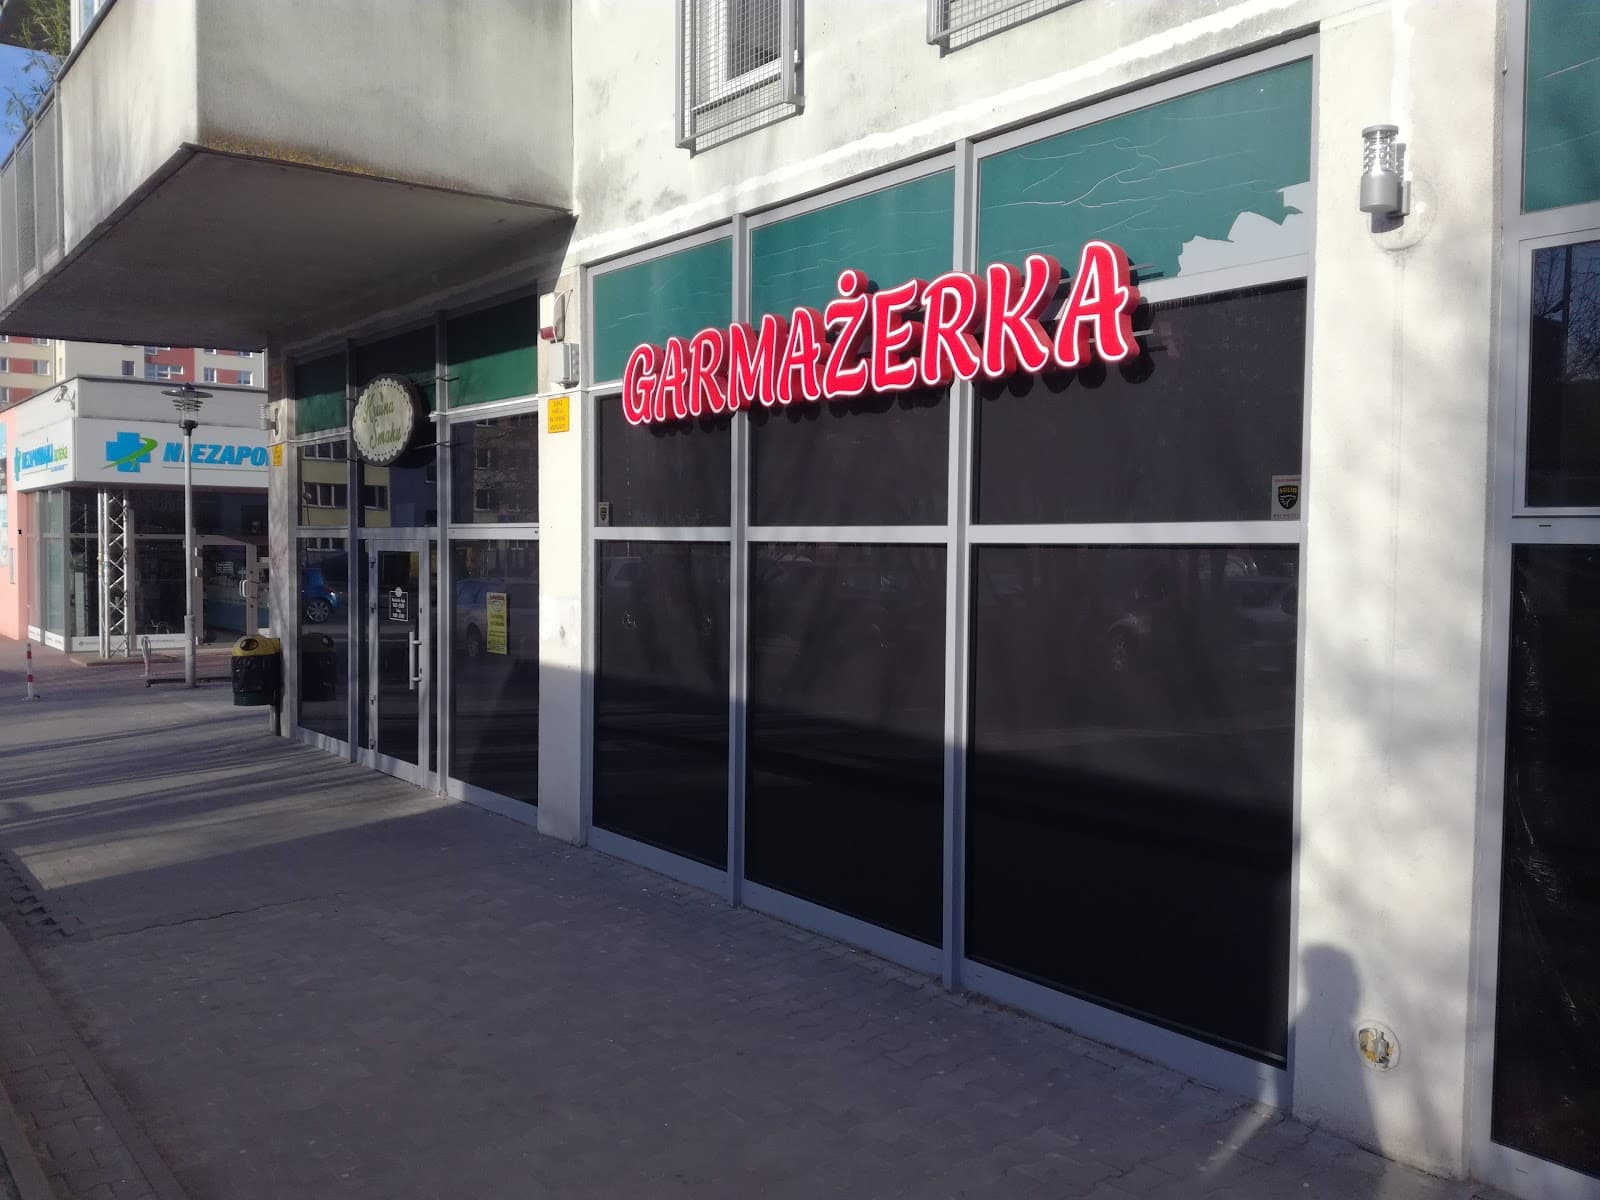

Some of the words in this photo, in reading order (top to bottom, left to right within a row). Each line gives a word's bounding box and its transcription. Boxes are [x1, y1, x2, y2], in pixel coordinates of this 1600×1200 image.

[622, 240, 1133, 425] GARMAŻERKA
[363, 391, 395, 423] Kraina
[370, 419, 402, 450] Smaku
[162, 442, 269, 467] NEZAPO
